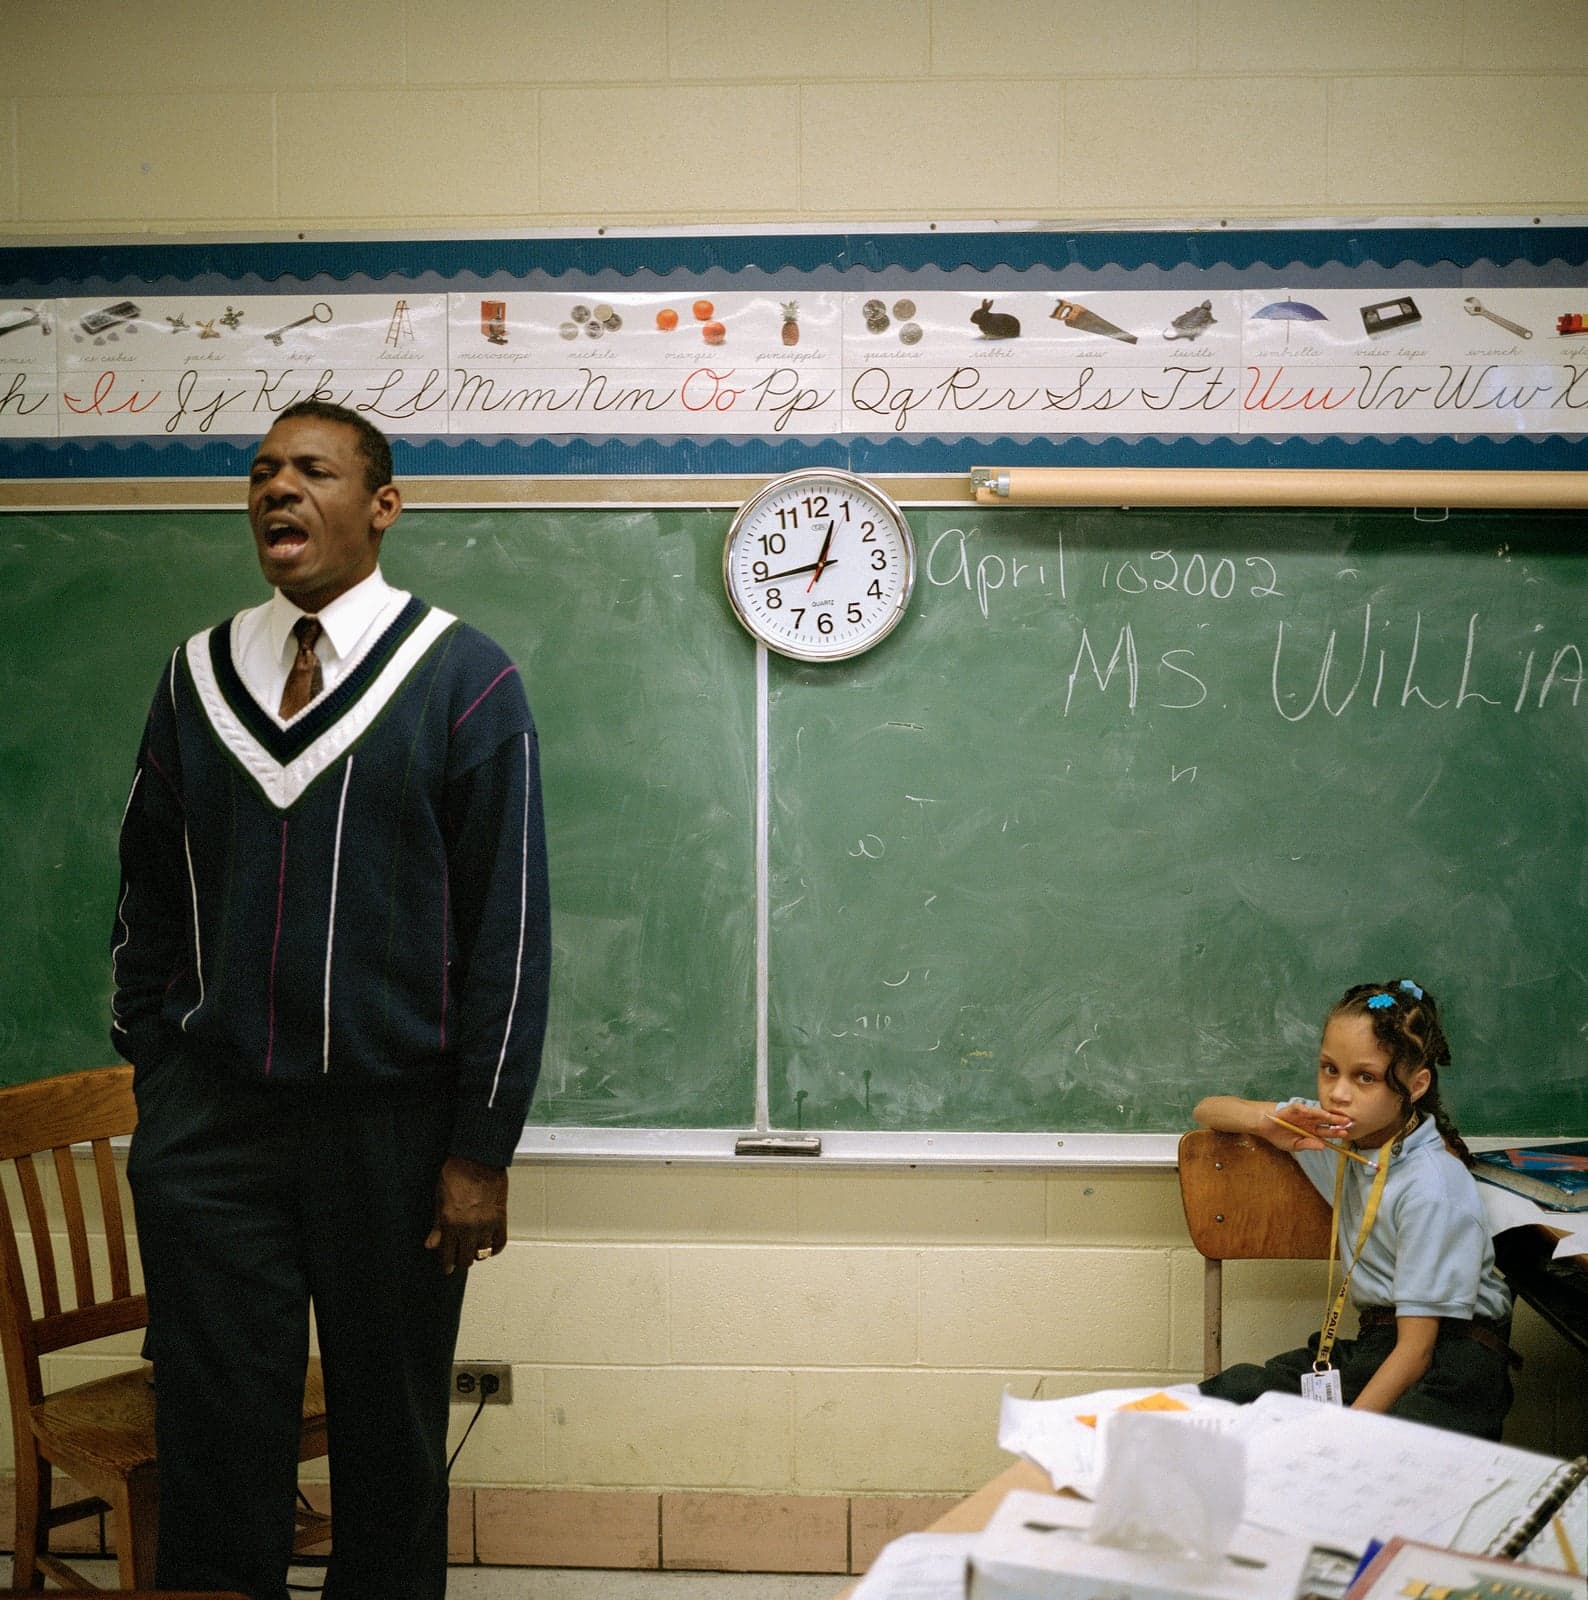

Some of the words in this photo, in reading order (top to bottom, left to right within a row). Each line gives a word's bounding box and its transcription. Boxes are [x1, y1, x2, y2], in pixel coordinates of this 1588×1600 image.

[457, 351, 531, 363] microscope
[754, 350, 826, 363] pineapple
[863, 350, 924, 361] quarters
[1168, 347, 1216, 358] turtle
[64, 371, 162, 416] Ii
[165, 370, 246, 432] Jj
[252, 369, 353, 411] Kk
[356, 369, 447, 418] Ll
[450, 369, 578, 411] Mm
[575, 368, 676, 411] Nn
[681, 368, 746, 411] Oo
[752, 368, 836, 432] Pp
[852, 367, 933, 431] Qq
[936, 367, 1040, 410] Rr
[1041, 367, 1135, 410] Ss
[1141, 367, 1236, 410] Tt
[1244, 366, 1356, 410] Uu
[1358, 366, 1432, 409] Vv
[1434, 365, 1553, 409] Ww
[801, 496, 830, 518] 12
[839, 501, 850, 522] 1
[776, 507, 798, 530] 11
[861, 521, 877, 542] 2
[758, 533, 786, 555] 10
[871, 549, 887, 570] 3
[752, 561, 769, 583] 9
[766, 588, 782, 609] 8
[867, 579, 883, 600] 4
[791, 608, 806, 629] 7
[847, 602, 862, 623] 5
[817, 613, 834, 634] 6
[1327, 1311, 1338, 1339] PAUL
